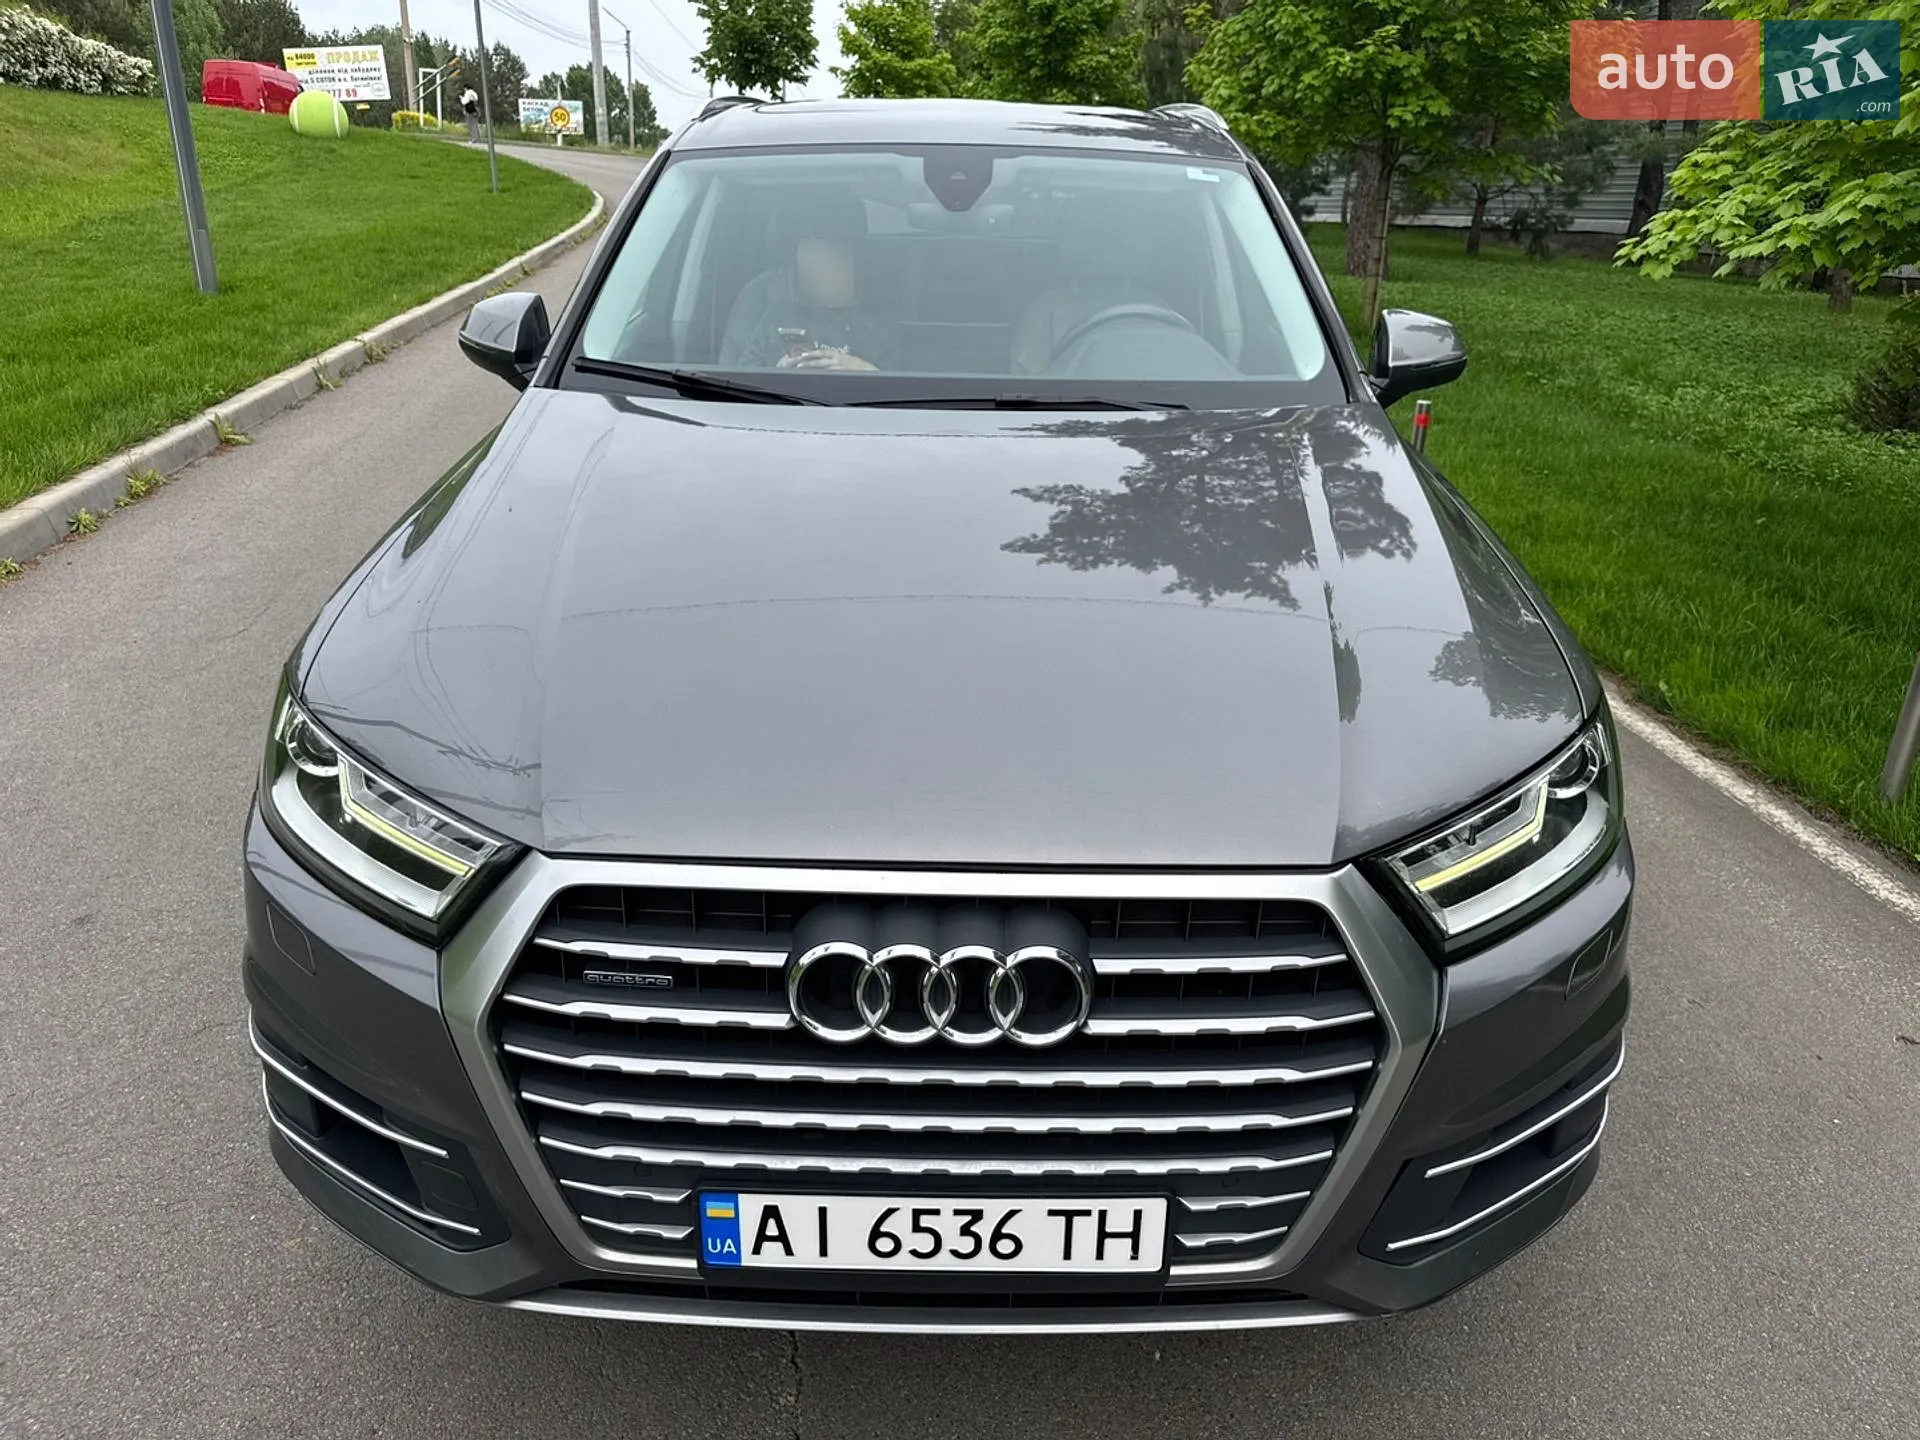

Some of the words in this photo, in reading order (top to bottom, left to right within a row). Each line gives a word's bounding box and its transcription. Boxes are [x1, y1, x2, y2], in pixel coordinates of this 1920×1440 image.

[327, 49, 379, 64] ПРОДАЖ
[554, 112, 566, 122] 50
[586, 974, 669, 987] quattro
[751, 1204, 829, 1257] AI
[867, 1207, 1024, 1260] 6536
[1047, 1208, 1142, 1261] TH
[707, 1238, 737, 1255] UA
